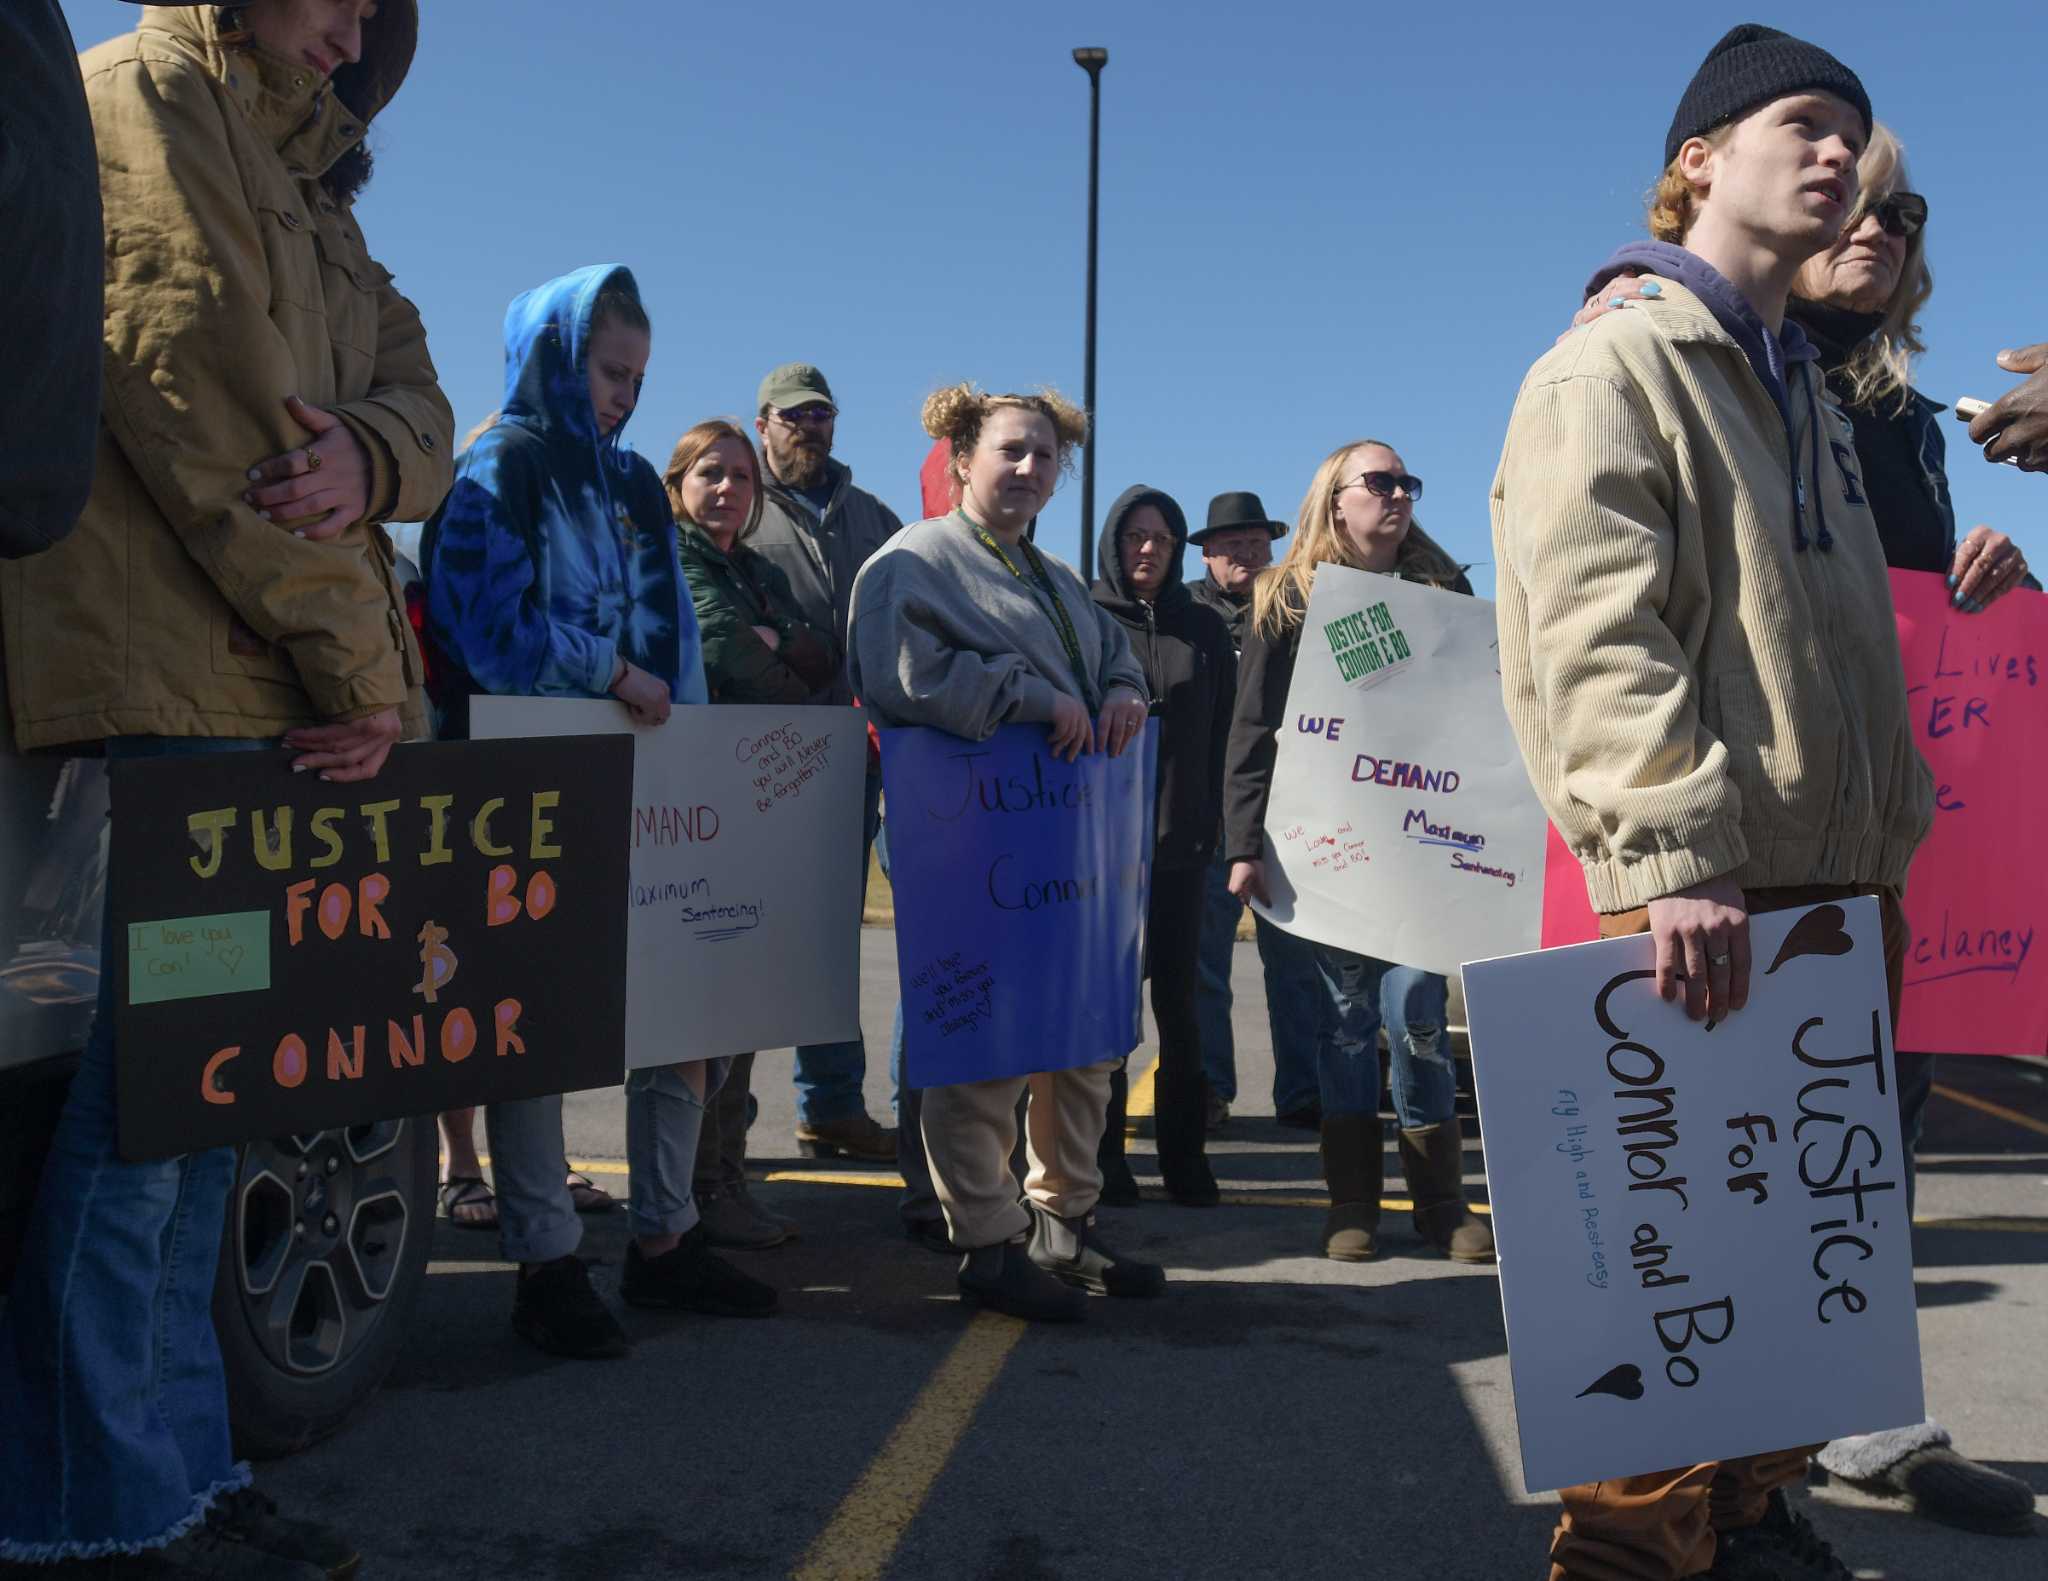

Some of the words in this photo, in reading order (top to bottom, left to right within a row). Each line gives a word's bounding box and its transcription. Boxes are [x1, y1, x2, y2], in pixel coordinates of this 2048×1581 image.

[1324, 611, 1372, 653] JUSTICE
[1366, 601, 1395, 634] FOR
[1336, 640, 1384, 682] CONNOR
[1388, 629, 1411, 660] BO
[1934, 624, 2038, 687] Lives
[736, 722, 792, 762] Connor
[1298, 714, 1344, 741] WE
[752, 773, 772, 792] you
[775, 755, 795, 774] will
[759, 745, 780, 769] and
[1352, 754, 1459, 793] DEMAND
[186, 790, 562, 878] JUSTICE
[1403, 809, 1485, 845] Maximum
[286, 872, 391, 945] FOR
[487, 864, 556, 926] BO
[130, 927, 149, 951] I
[161, 925, 193, 944] love
[200, 927, 232, 955] you
[1906, 908, 2034, 985] elaney
[201, 998, 525, 1104] CONNOR
[1594, 968, 1717, 1212] Connor
[1556, 1124, 1595, 1163] High
[1575, 1170, 1596, 1200] and
[1630, 1223, 1690, 1288] and
[1653, 1295, 1734, 1387] Bo
